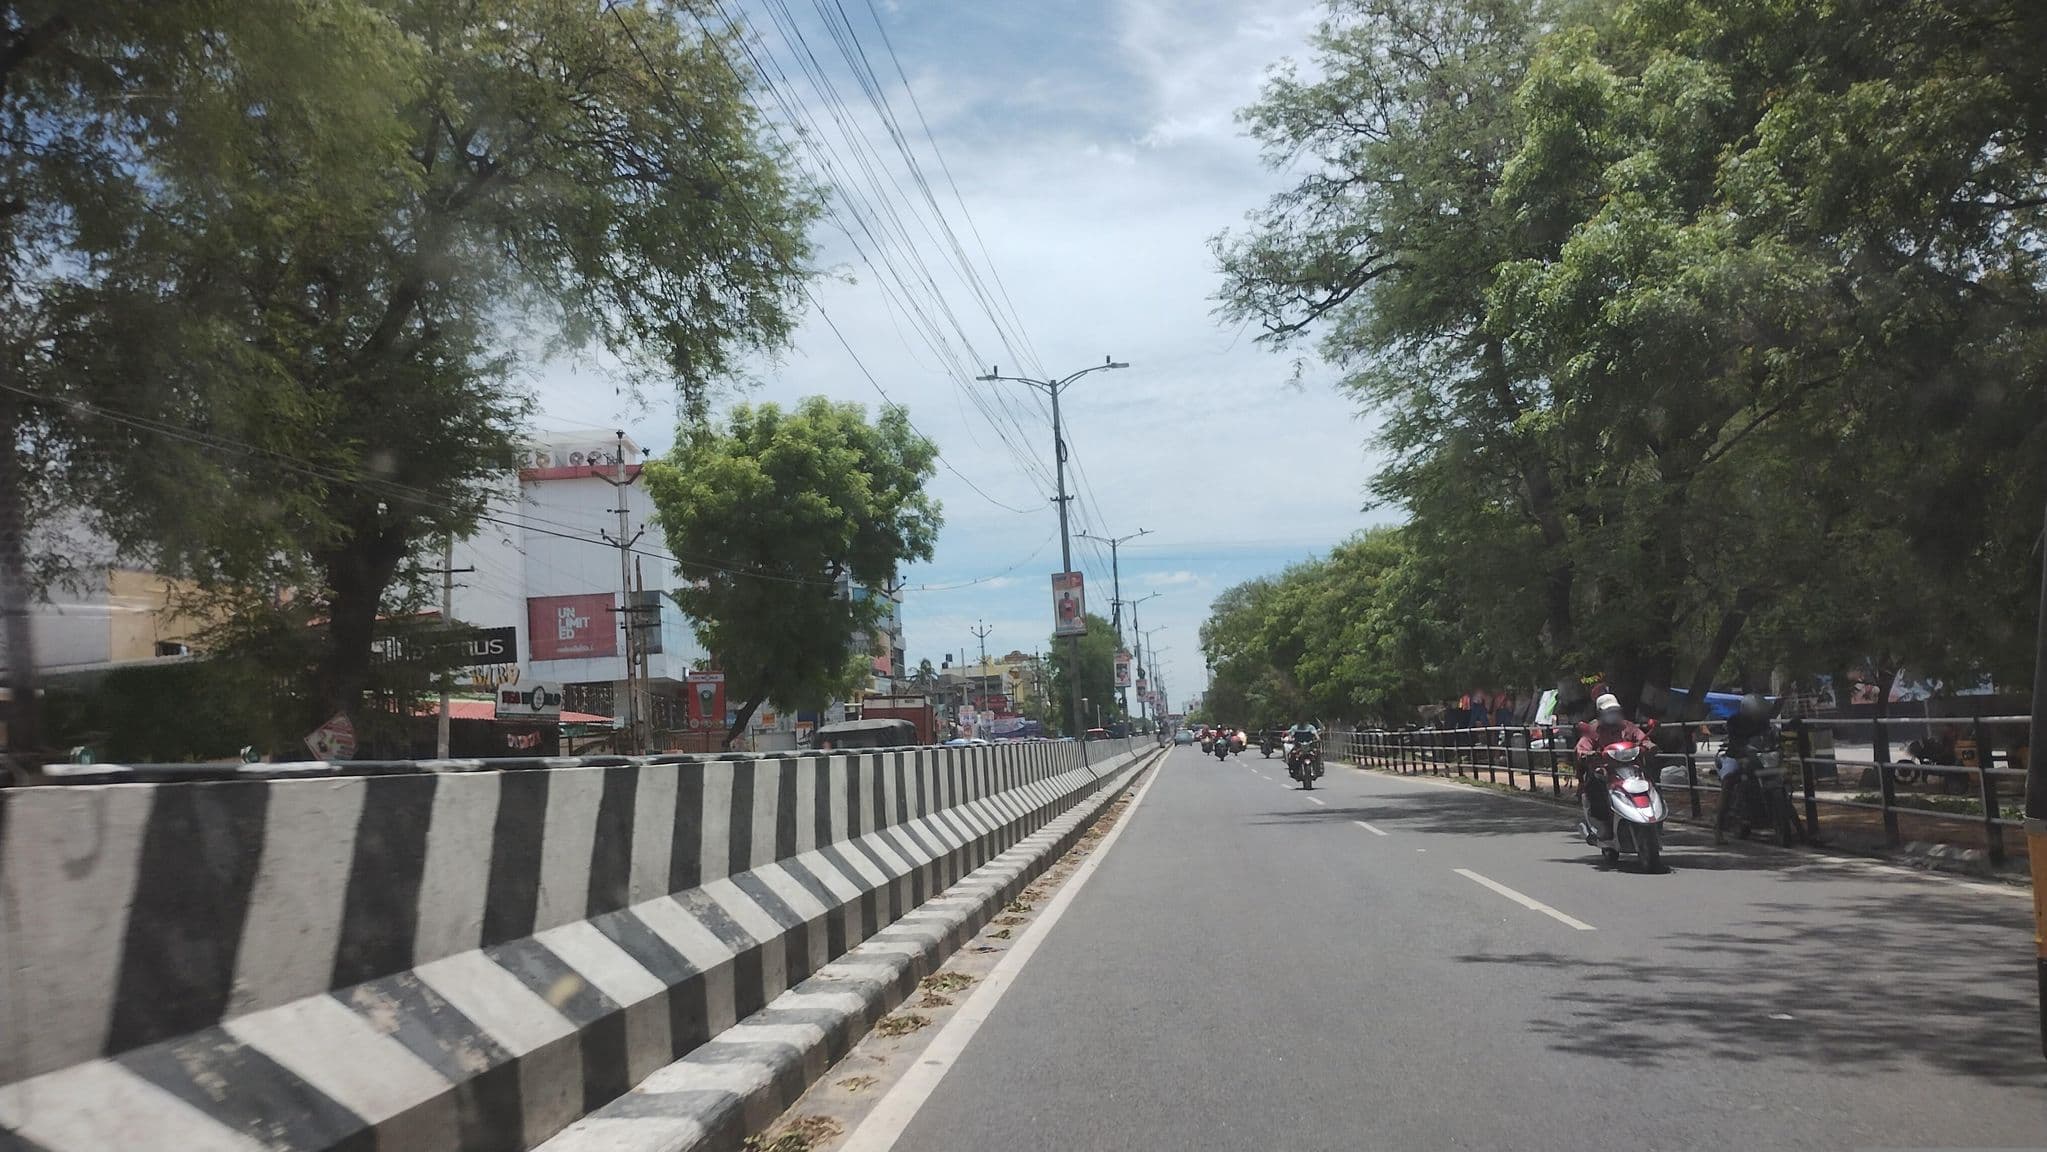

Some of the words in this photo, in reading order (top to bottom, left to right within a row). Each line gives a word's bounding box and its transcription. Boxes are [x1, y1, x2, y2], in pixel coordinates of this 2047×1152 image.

[558, 607, 575, 619] UN
[558, 616, 590, 629] LIMIT
[558, 628, 575, 640] ED
